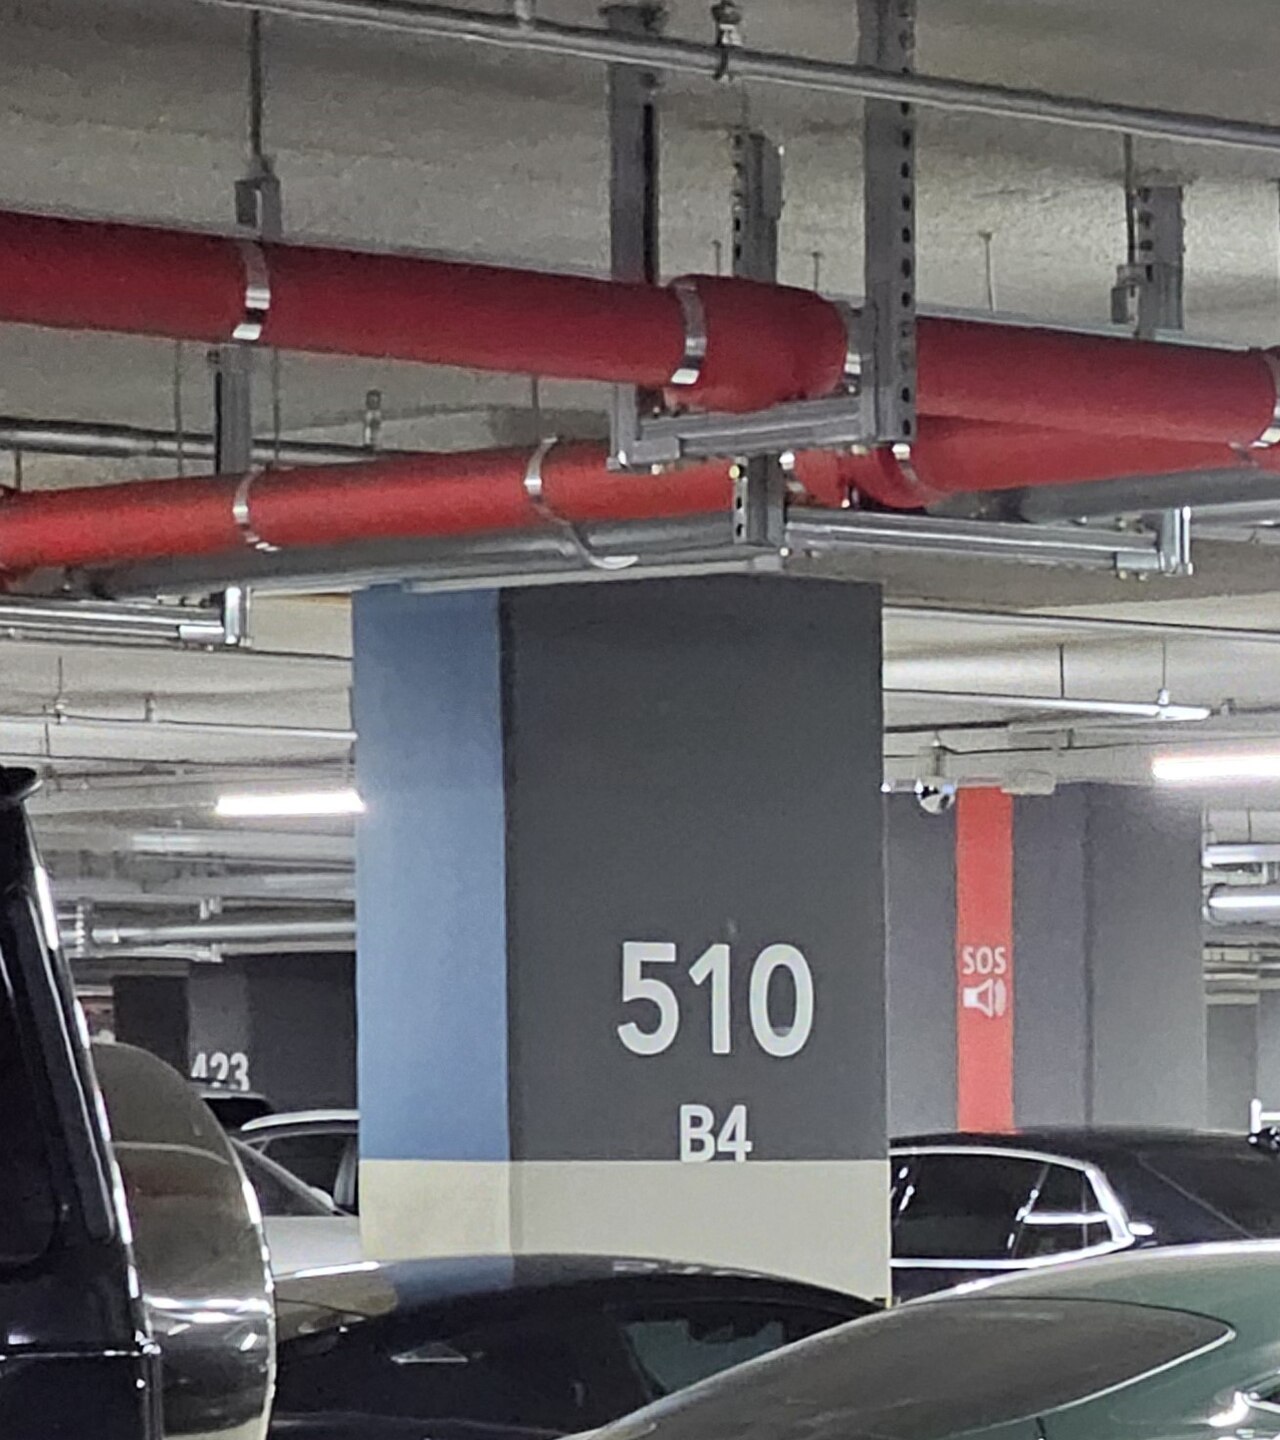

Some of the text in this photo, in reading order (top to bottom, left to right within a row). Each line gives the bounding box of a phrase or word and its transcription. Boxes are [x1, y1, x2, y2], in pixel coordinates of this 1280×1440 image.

[962, 945, 1007, 975] SOS
[617, 941, 814, 1057] 510
[190, 1051, 250, 1092] 423
[680, 1104, 753, 1163] B4
